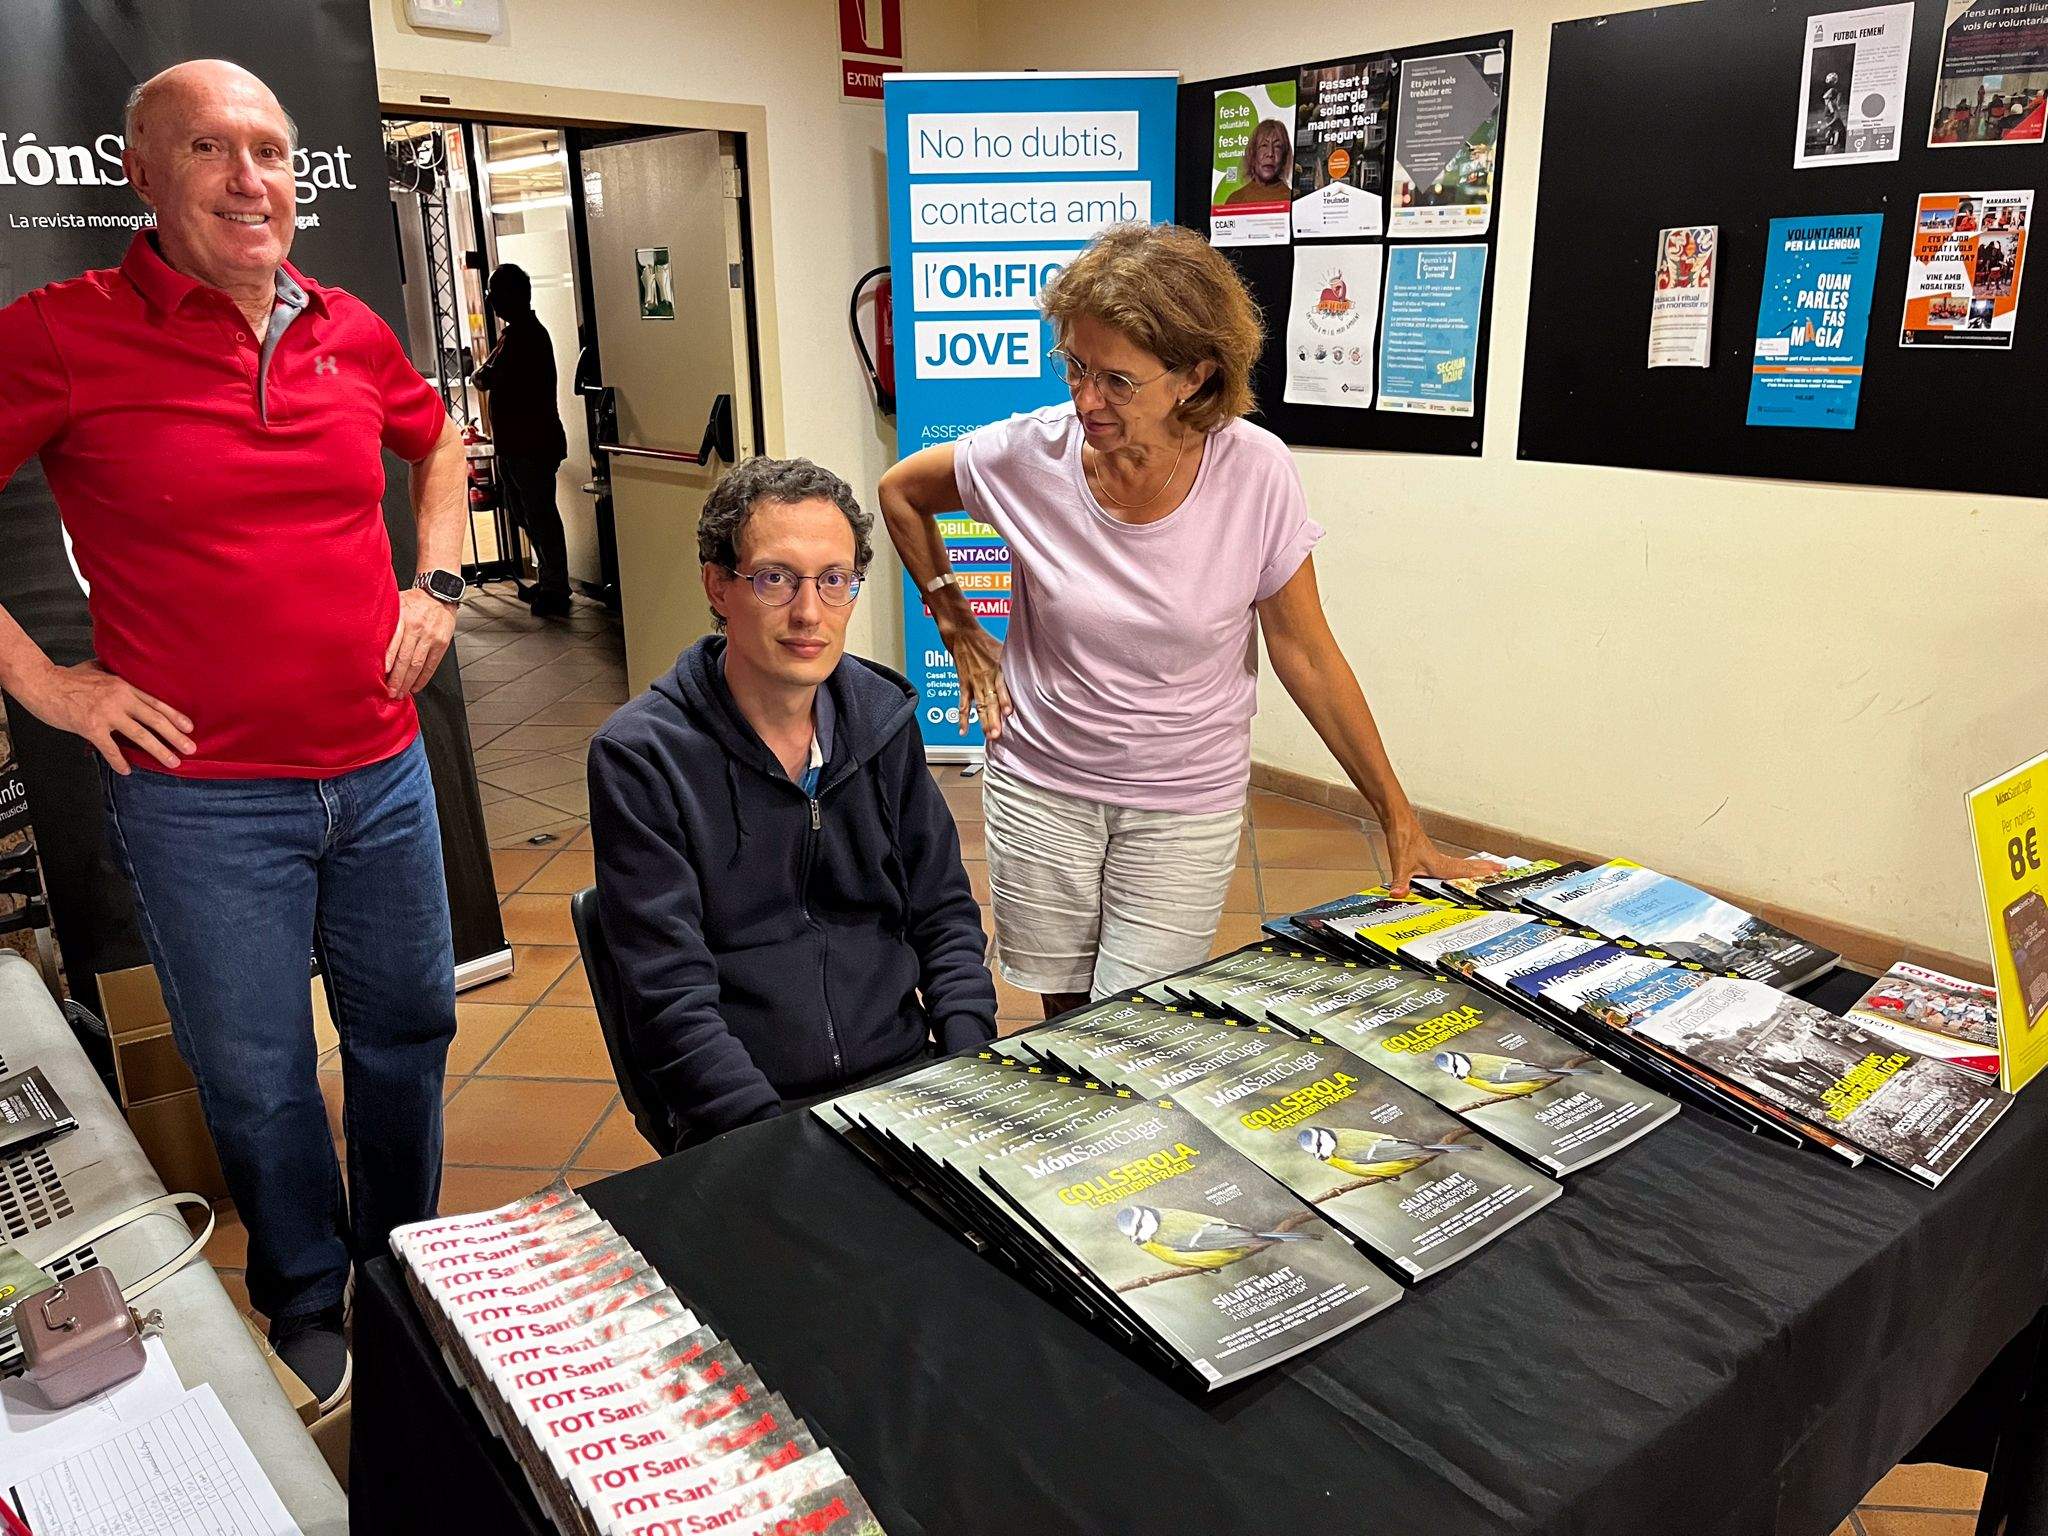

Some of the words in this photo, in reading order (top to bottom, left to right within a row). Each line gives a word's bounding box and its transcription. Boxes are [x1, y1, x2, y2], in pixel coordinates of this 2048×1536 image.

[1963, 20, 1981, 31] vols
[1983, 20, 1997, 29] fer
[1998, 15, 2048, 28] voluntaria
[1964, 9, 1986, 18] Tens
[1987, 8, 2001, 16] un
[2002, 4, 2027, 14] matí
[1833, 30, 1857, 41] FUTBOL
[1859, 24, 1885, 38] FEMENÍ
[1319, 76, 1361, 90] Passa't
[1362, 77, 1370, 86] a
[1410, 80, 1422, 88] Ets
[1421, 79, 1437, 89] jove
[1441, 76, 1457, 85] vols
[1410, 89, 1440, 98] treballar
[1319, 88, 1369, 104] l'energia
[1219, 105, 1250, 119] fes-te
[1308, 118, 1351, 131] manera
[1352, 112, 1378, 126] fàcil
[1320, 104, 1350, 117] solar
[1351, 102, 1366, 113] de
[919, 128, 964, 159] No
[974, 127, 1012, 158] ho
[1022, 126, 1123, 161] dubtis,
[1218, 134, 1249, 148] fes-te
[1323, 129, 1364, 144] segura
[921, 197, 1057, 225] contacta
[1067, 192, 1138, 223] amb
[1323, 197, 1350, 205] Teulada
[9, 213, 31, 228] La
[32, 213, 86, 228] revista
[88, 212, 157, 230] monogràf
[1787, 226, 1862, 241] VOLUNTARIAT
[1785, 240, 1803, 251] PER
[1805, 240, 1816, 251] LA
[1818, 239, 1861, 250] LLENGUA
[1817, 273, 1851, 290] QUAN
[1681, 294, 1700, 302] ritual
[1797, 290, 1849, 309] PARLES
[1823, 310, 1846, 327] FAS
[925, 332, 1029, 367] JOVE
[2002, 817, 2013, 834] Per
[2013, 805, 2037, 831] només
[2007, 827, 2041, 881] 8€
[1552, 870, 1633, 904] MónSantCugat
[1388, 910, 1479, 942] MónSantCugat
[1467, 928, 1557, 969] MónSantCugat
[1898, 964, 1936, 979] TOT
[1934, 976, 1974, 993] Sant
[1301, 975, 1404, 1017] MónSantCugat
[1613, 972, 1703, 1018] MónSantCugat
[1344, 987, 1450, 1035] MónSantCugat
[1150, 1037, 1270, 1090] MónSantCugat
[1203, 1049, 1325, 1109] MónSantCugat
[1562, 1091, 1592, 1113] MUNT
[1022, 1115, 1170, 1180] MónSantCugat
[1398, 1190, 1438, 1213] SÍLVIA
[1430, 1172, 1466, 1195] MUNT
[436, 1270, 485, 1290] TOT
[1211, 1285, 1259, 1310] SÍLVIA
[1252, 1266, 1296, 1292] MUNT
[1232, 1298, 1252, 1312] GENT
[1266, 1275, 1306, 1300] ACOSTUMAT
[463, 1306, 513, 1325] TOT
[515, 1294, 567, 1316] Sant
[474, 1325, 526, 1347] TOT
[514, 1366, 560, 1390] TOT
[561, 1355, 615, 1380] Sant
[527, 1389, 577, 1413] TOT
[579, 1379, 627, 1401] San
[547, 1414, 597, 1438] TOT
[565, 1440, 617, 1466] TOT
[588, 1468, 646, 1494] TOT
[686, 1500, 747, 1532] Sant
[774, 1497, 849, 1536] Cugat
